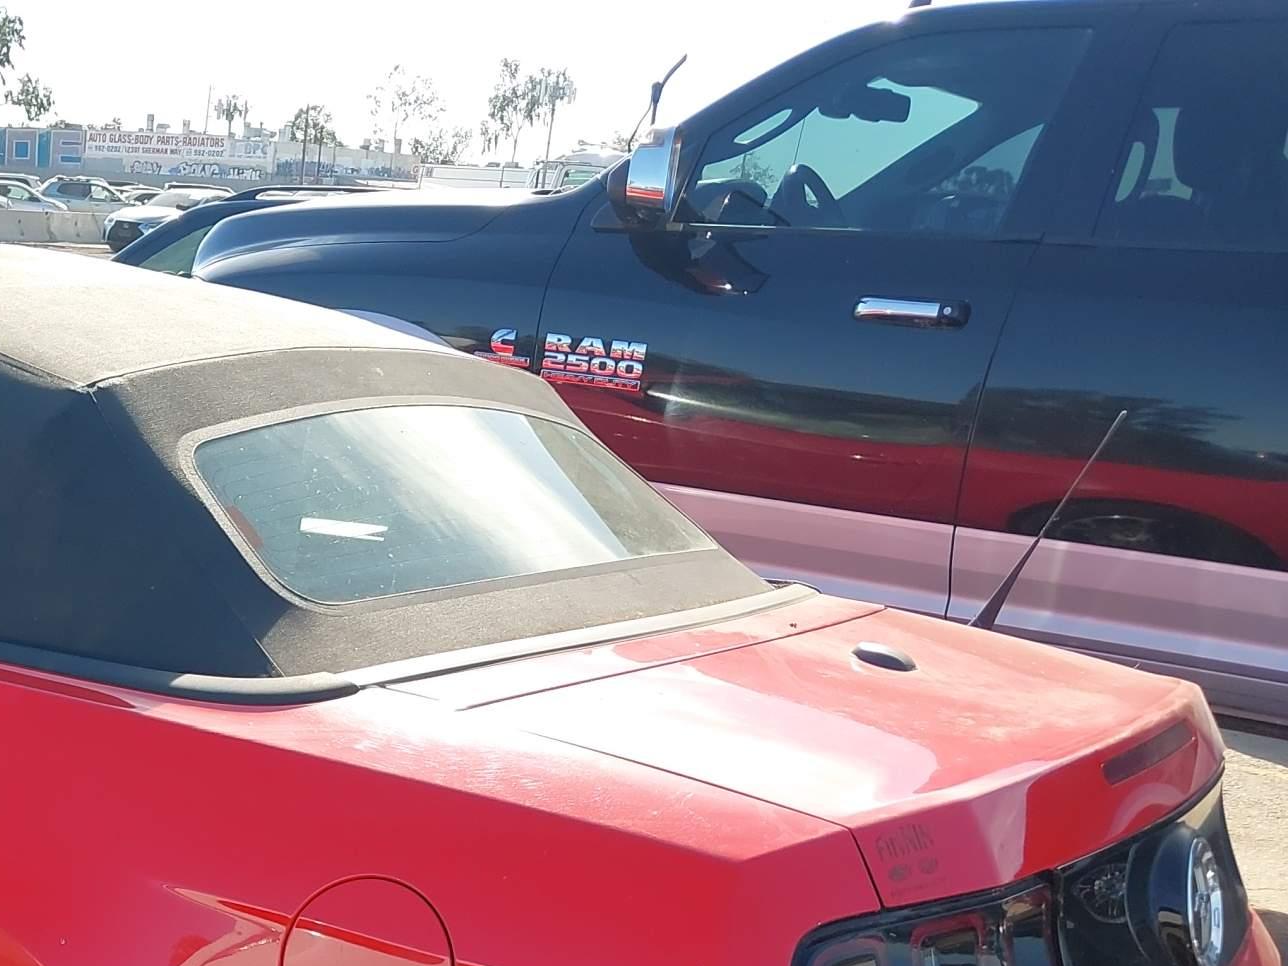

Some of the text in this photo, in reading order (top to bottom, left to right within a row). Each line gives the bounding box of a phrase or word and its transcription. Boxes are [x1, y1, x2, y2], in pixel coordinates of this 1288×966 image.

[88, 133, 107, 143] AUTO
[544, 332, 648, 362] RAM
[542, 352, 643, 379] 2500
[593, 377, 637, 390] DUTY
